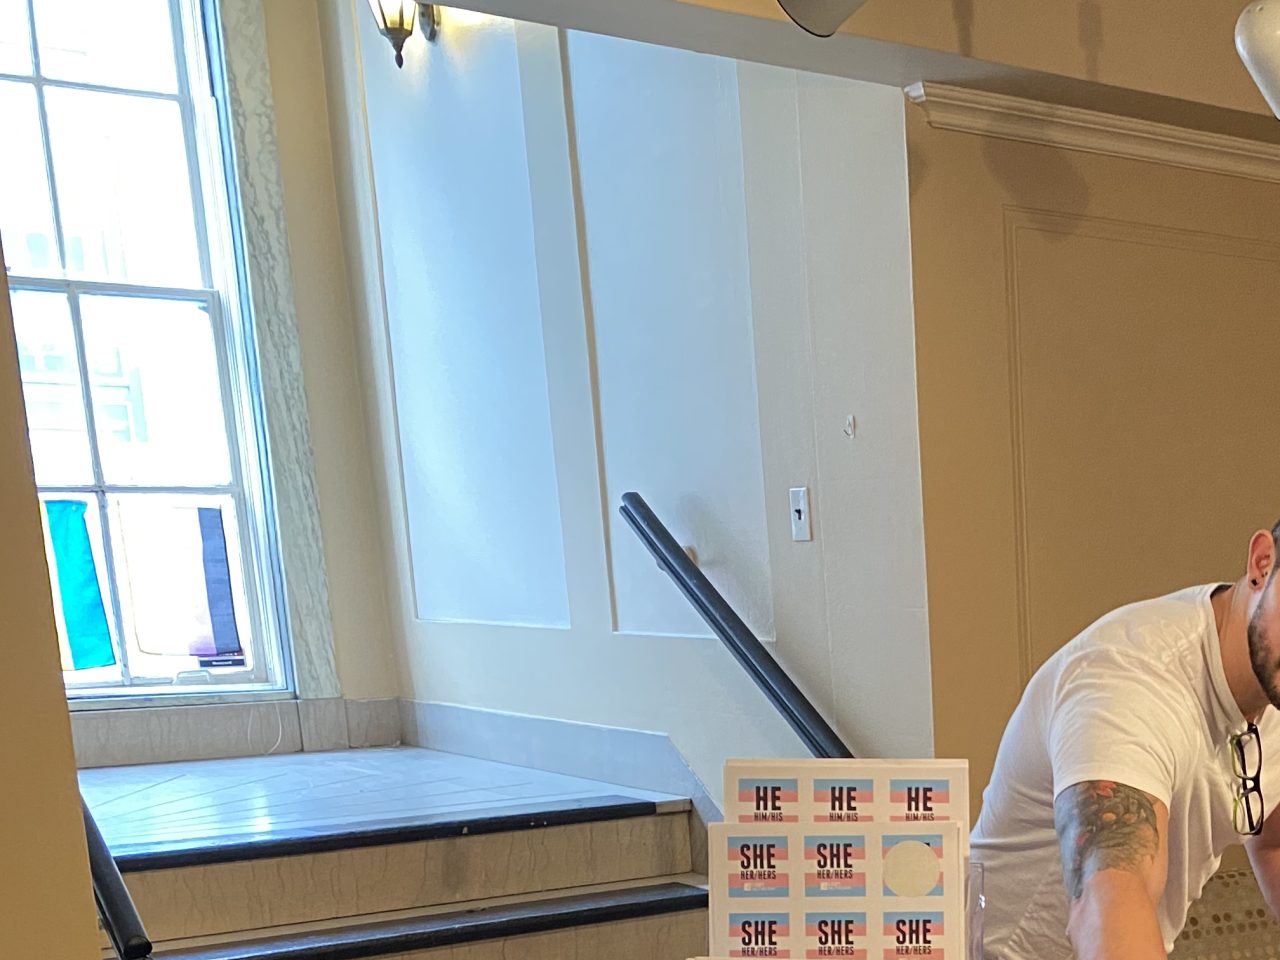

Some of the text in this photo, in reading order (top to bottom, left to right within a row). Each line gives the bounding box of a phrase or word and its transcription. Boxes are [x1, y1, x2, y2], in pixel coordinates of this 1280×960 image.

[755, 786, 782, 811] HE
[831, 786, 857, 811] HE
[907, 787, 933, 812] HE
[740, 844, 777, 869] SHE
[816, 843, 853, 869] SHE
[740, 869, 777, 880] HER/HERS
[816, 869, 854, 879] HER/HERS
[741, 920, 777, 946] SHE
[818, 920, 854, 946] SHE
[895, 919, 932, 945] SHE
[741, 947, 777, 957] HER/HERS
[818, 946, 854, 956] HER/HERS
[895, 945, 932, 956] HER/HERS
